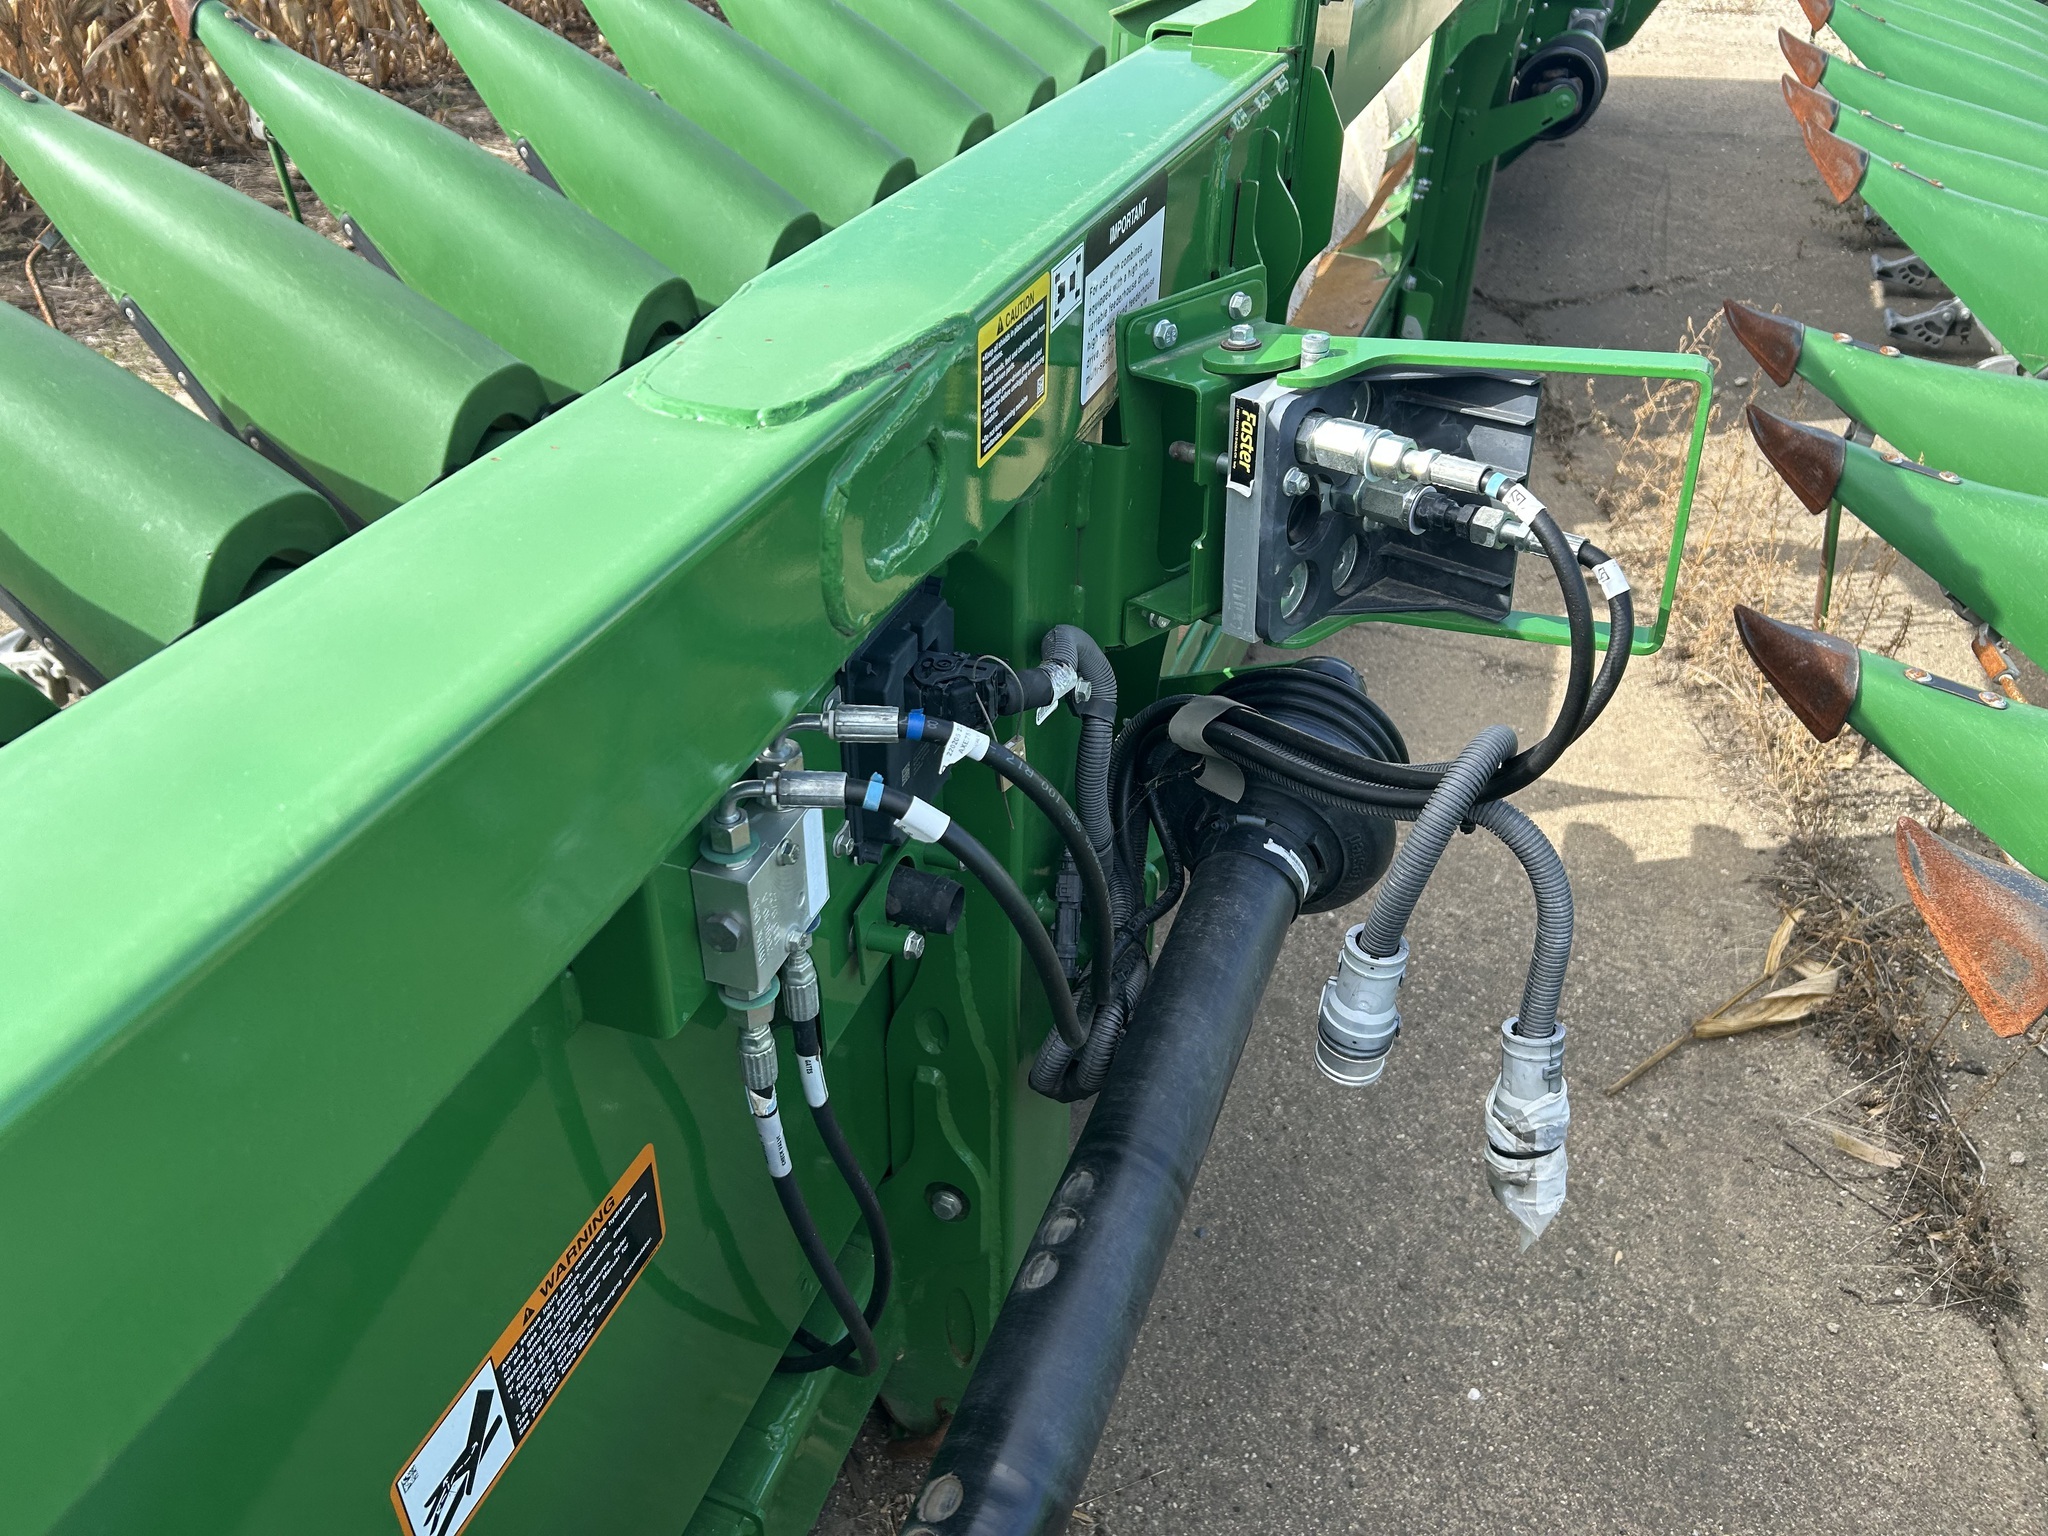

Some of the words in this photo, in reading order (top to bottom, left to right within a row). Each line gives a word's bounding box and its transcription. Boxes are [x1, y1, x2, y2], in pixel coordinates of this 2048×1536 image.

[1109, 197, 1148, 244] IMPORTANT
[1088, 287, 1111, 316] equipped
[1113, 277, 1122, 292] with
[1124, 274, 1126, 282] a
[1128, 263, 1138, 278] high
[1139, 249, 1152, 267] torque
[1089, 284, 1098, 298] For
[1099, 275, 1108, 289] use
[1110, 264, 1119, 279] with
[1121, 243, 1142, 269] combines
[1006, 292, 1034, 327] CAUTION
[1087, 334, 1098, 350] high
[1129, 277, 1154, 308] feederhouse
[1088, 309, 1107, 333] variable
[1109, 280, 1137, 311] feederhouse
[1102, 341, 1107, 352] or
[1239, 410, 1256, 474] Faster
[1005, 756, 1034, 778] R17
[1041, 782, 1060, 804] 100
[1065, 811, 1082, 832] SAE
[804, 1060, 814, 1075] GATES
[541, 1197, 614, 1296] WARNING
[502, 1346, 518, 1371] Avoid
[520, 1317, 541, 1345] serious
[542, 1292, 558, 1314] injury
[560, 1273, 573, 1290] from
[575, 1244, 594, 1271] contact
[596, 1227, 607, 1242] with
[608, 1195, 630, 1226] hydraulic
[505, 1359, 524, 1386] Before
[526, 1321, 552, 1357] removing
[553, 1286, 577, 1319] hydraulic
[613, 1192, 647, 1238] disassembling
[516, 1362, 536, 1391] Relieve
[538, 1333, 557, 1360] system
[559, 1297, 583, 1330] hydraulic
[585, 1261, 610, 1296] pressures.
[614, 1237, 626, 1256] Refer
[539, 1307, 554, 1329] under
[557, 1273, 581, 1306] pressure.
[516, 1345, 542, 1381] changing
[544, 1293, 580, 1343] accumulators:
[526, 1352, 549, 1386] Operator
[552, 1323, 570, 1350] Manual
[584, 1282, 600, 1305] Repair
[602, 1254, 620, 1280] Manual
[530, 1392, 542, 1410] only
[558, 1330, 585, 1370] NITROGEN
[596, 1279, 622, 1315] recharging
[520, 1377, 540, 1405] system
[542, 1332, 572, 1374] information.
[521, 1393, 535, 1412] Stop
[537, 1365, 555, 1390] engine
[568, 1318, 587, 1345] remove
[589, 1303, 599, 1316] key.
[532, 1398, 544, 1418] your
[546, 1376, 560, 1396] John
[561, 1352, 576, 1374] Deere
[578, 1327, 595, 1350] dealer.
